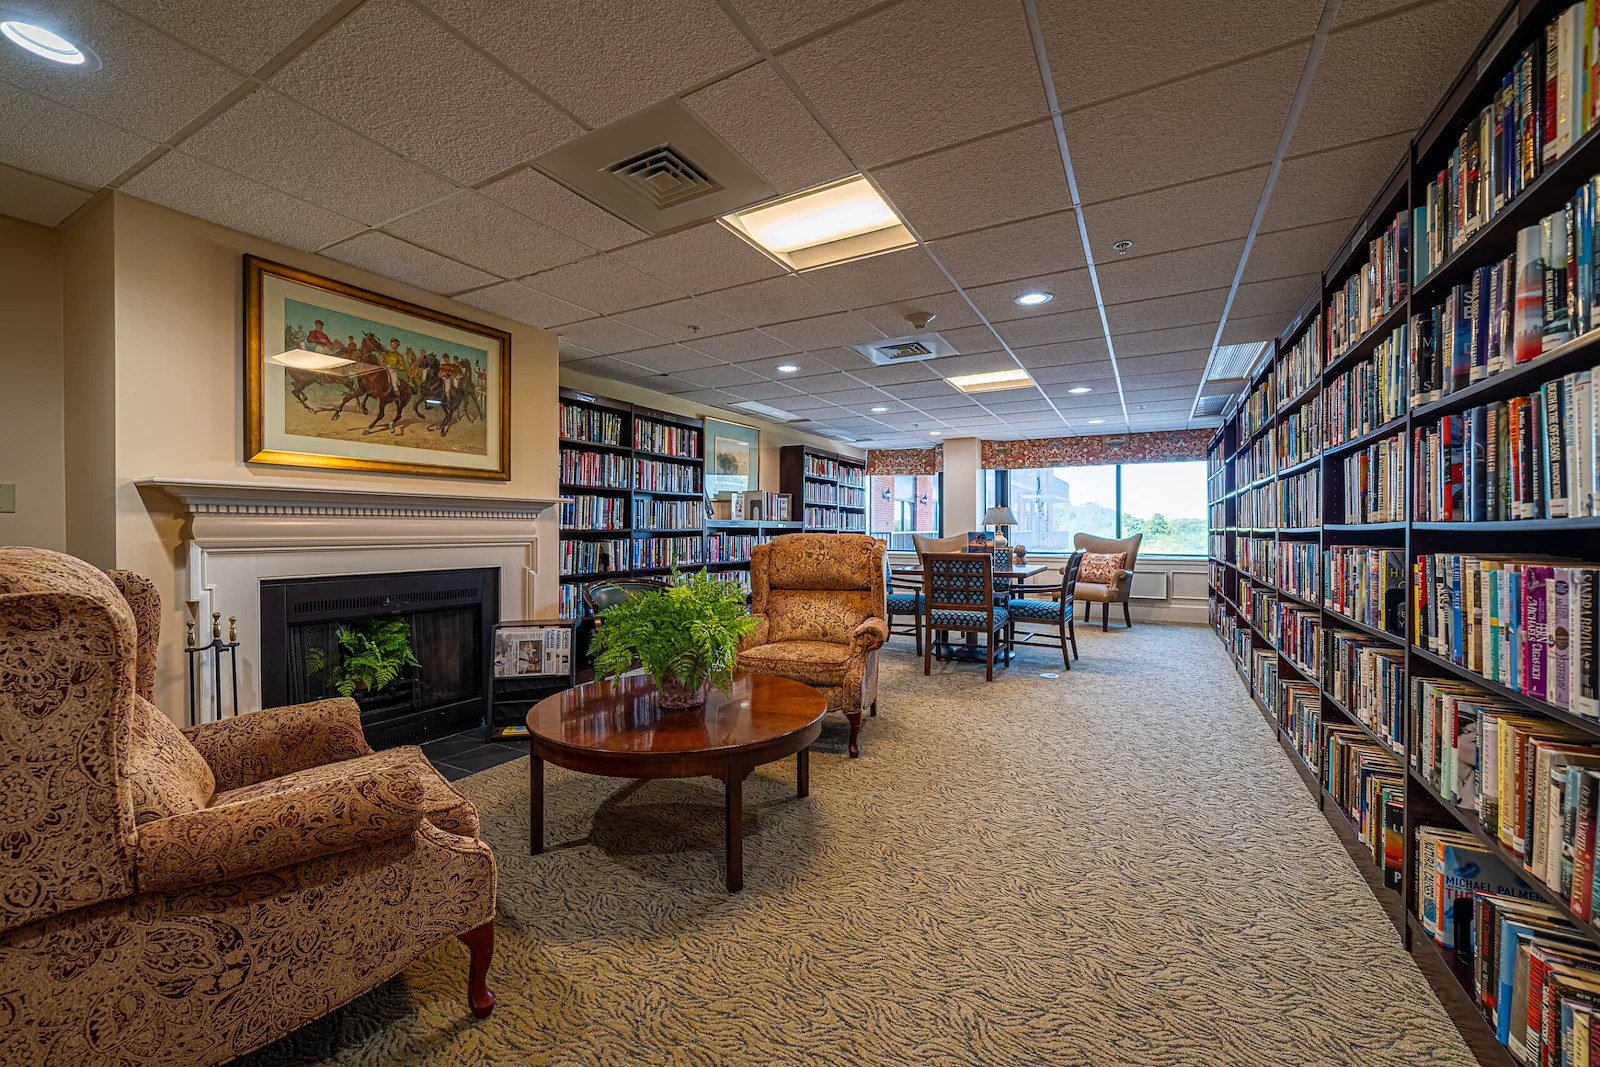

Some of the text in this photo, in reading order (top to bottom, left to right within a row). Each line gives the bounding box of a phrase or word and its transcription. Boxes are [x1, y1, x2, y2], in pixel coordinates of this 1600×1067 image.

[1546, 270, 1554, 280] THE
[1546, 302, 1554, 321] LAWYER
[1547, 383, 1558, 404] DEATH
[1548, 404, 1558, 412] IN
[1549, 412, 1559, 424] THE
[1564, 378, 1574, 446] SANDRA BROWN
[1487, 410, 1496, 472] NORMAN MAILER
[1550, 424, 1561, 461] OFF-SEASON
[1560, 604, 1569, 620] FERN
[1580, 574, 1593, 661] SANDRA BROWN
[1527, 596, 1537, 642] MICHAELS
[1532, 643, 1542, 664] VEGAS
[1535, 623, 1548, 643] FERN
[1556, 654, 1568, 690] YESTERDAY
[1577, 785, 1590, 850] OLIVER NORTH
[1424, 840, 1434, 871] NATURAL
[1424, 871, 1434, 898] CAUSES
[1446, 875, 1543, 902] MICHAEL PALMER
[1446, 888, 1473, 900] THE
[1483, 904, 1491, 922] JOHN
[1482, 924, 1490, 956] GRISHAM
[1576, 992, 1592, 1001] NEW
[1525, 1025, 1540, 1066] MOTIVE
